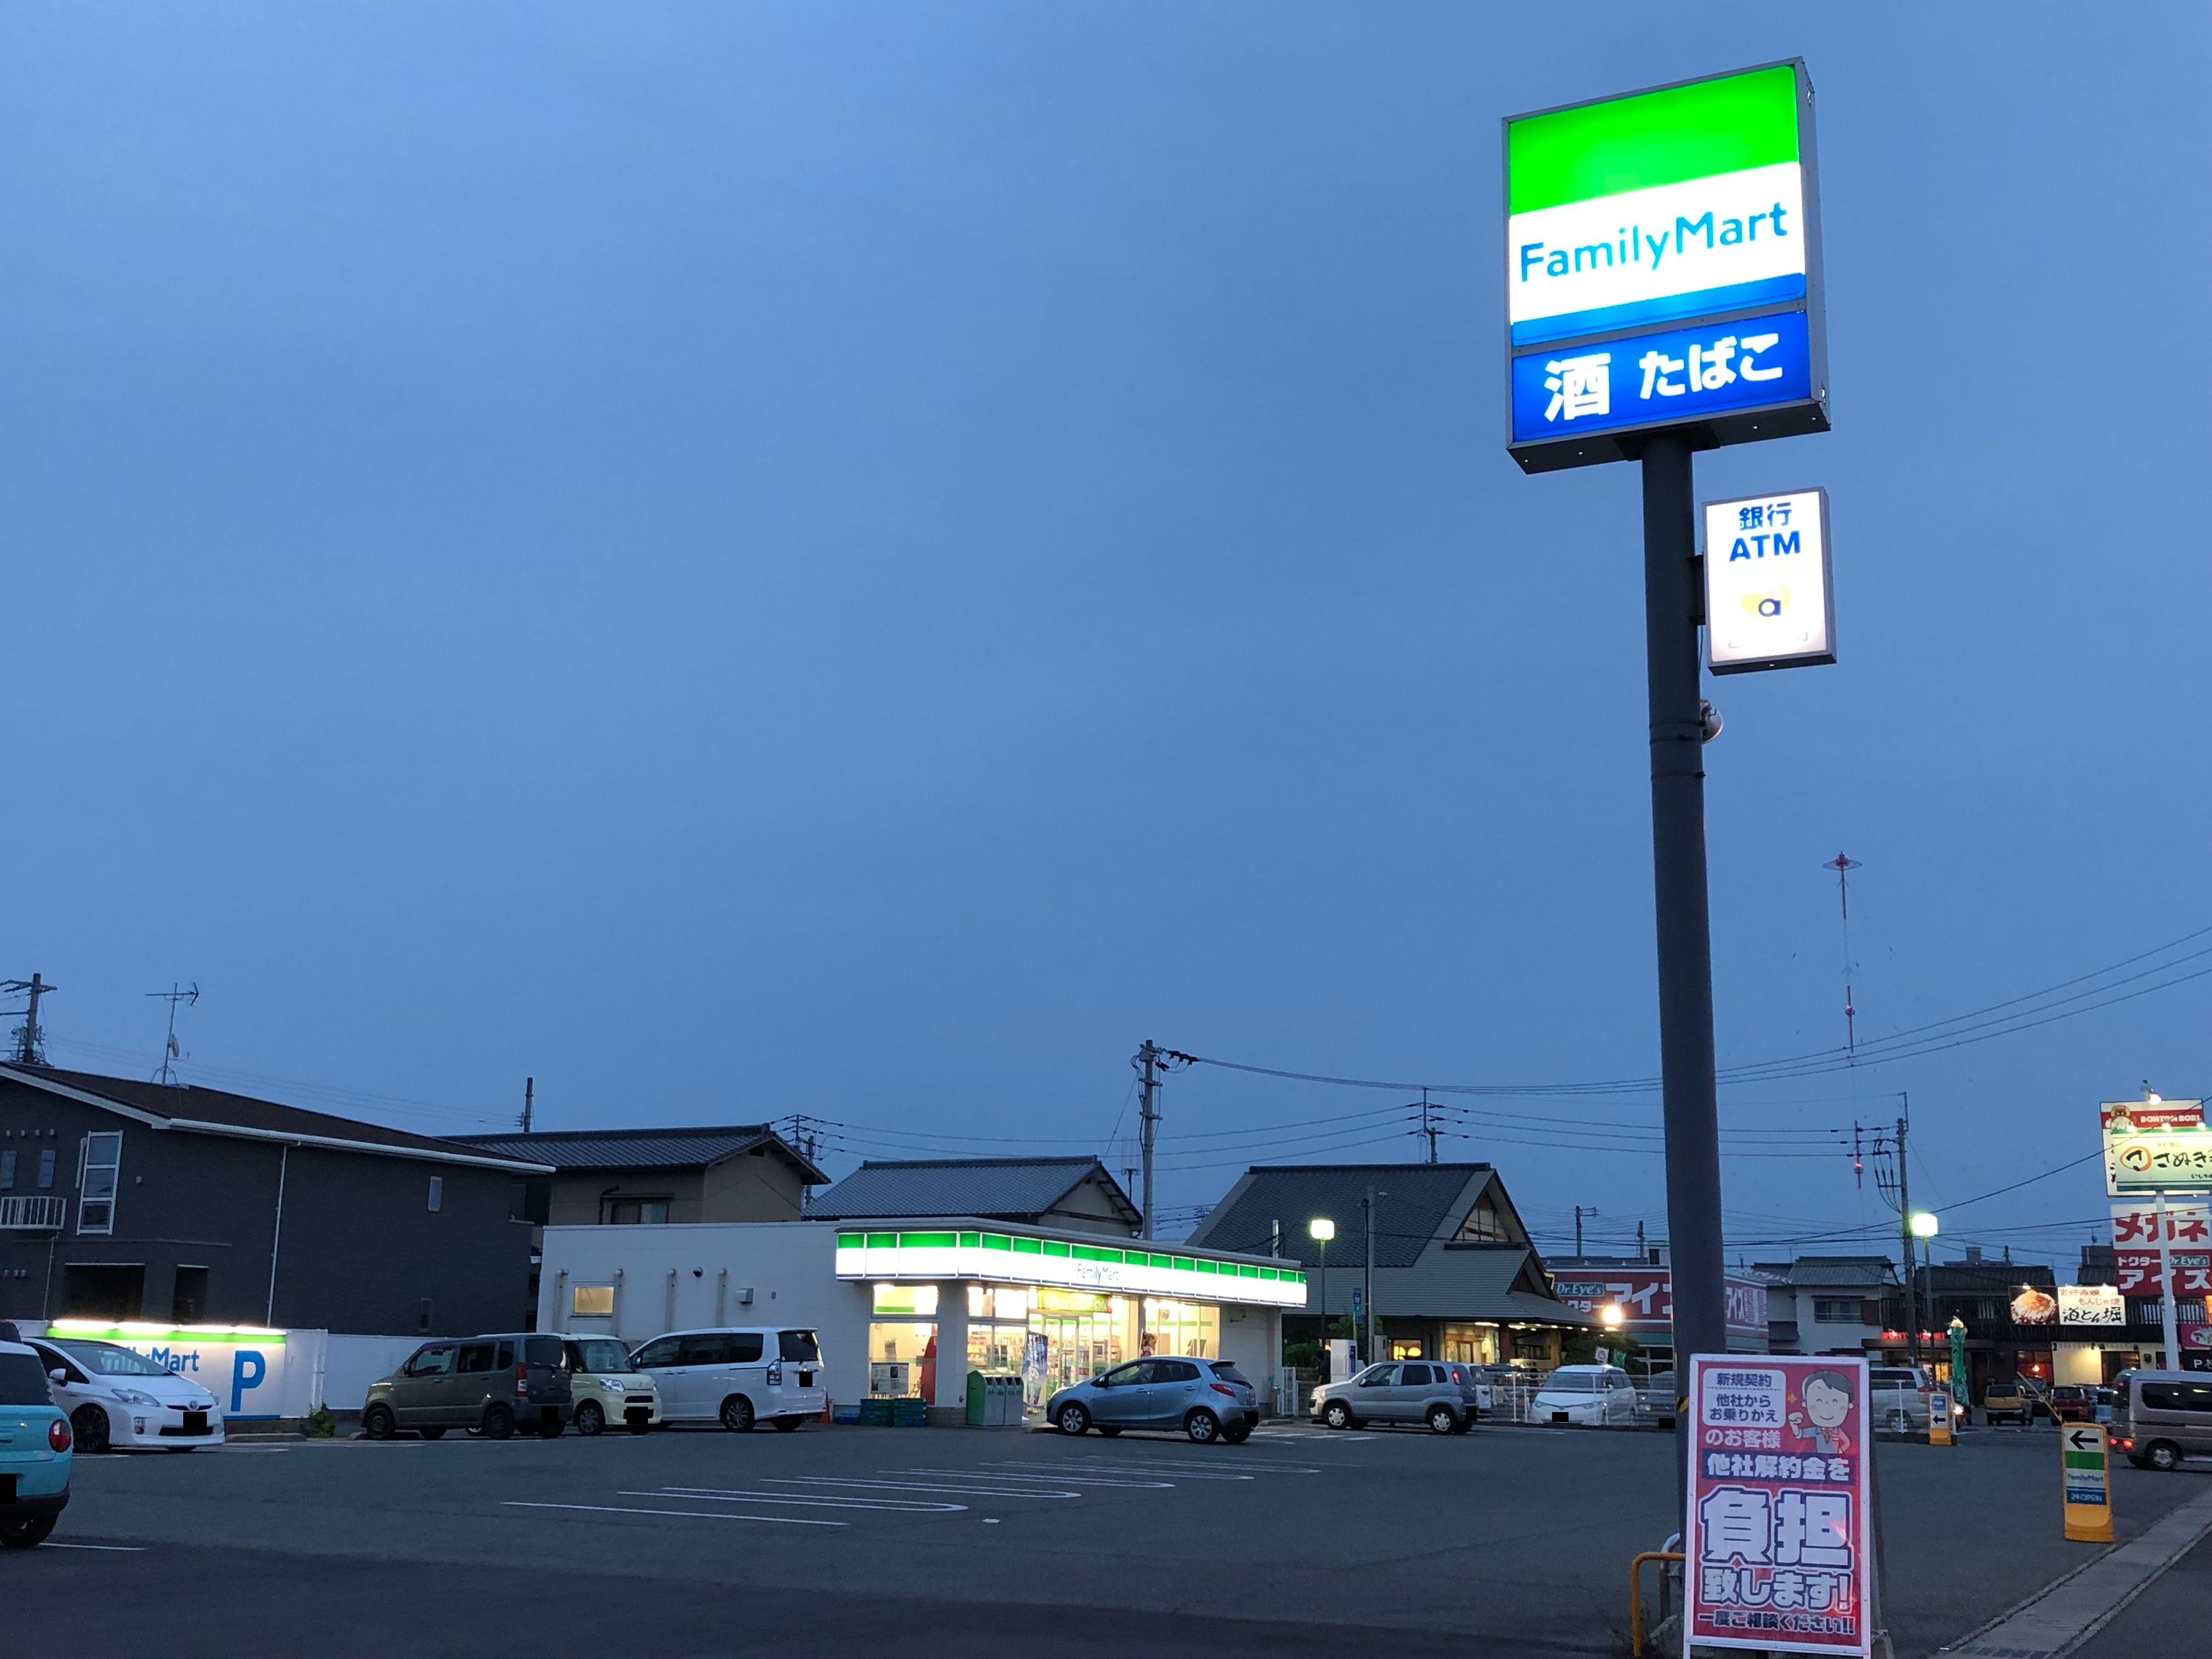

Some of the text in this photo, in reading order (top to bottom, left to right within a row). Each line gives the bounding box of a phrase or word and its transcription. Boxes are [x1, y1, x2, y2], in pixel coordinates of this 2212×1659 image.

[1521, 201, 1788, 282] FamilyMart
[1543, 332, 1784, 422] 酒 たばこ
[1739, 502, 1792, 531] 銀行
[1729, 531, 1801, 562] ATM
[2153, 1151, 2212, 1169] さぬき
[2115, 1211, 2209, 1243] メガネ
[1562, 1300, 1604, 1313] クター
[2062, 1306, 2124, 1324] 道とん堀
[230, 1350, 266, 1412] P
[1717, 1373, 1772, 1387] 新規契約
[1716, 1393, 1771, 1408] 他社から
[1709, 1408, 1778, 1423] お乗りかえ
[1705, 1429, 1781, 1448] のお客様
[1707, 1453, 1850, 1481] 他社解約金を
[1701, 1487, 1851, 1568] 負担
